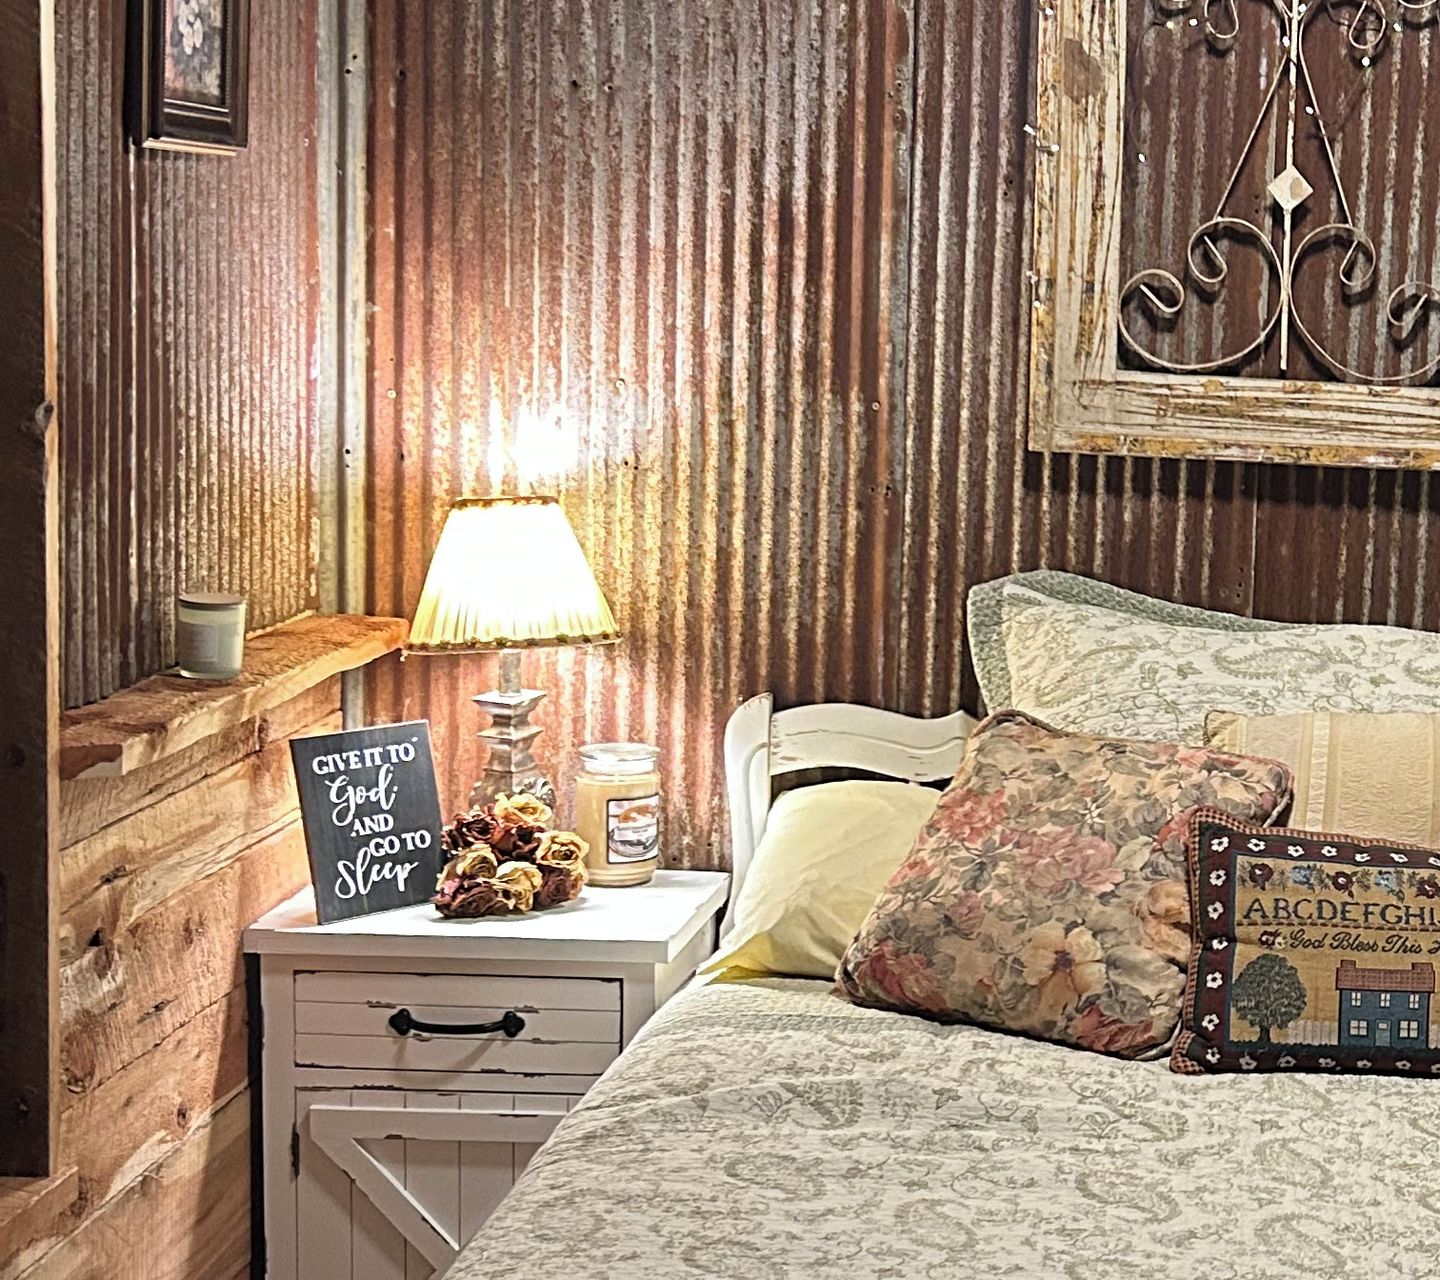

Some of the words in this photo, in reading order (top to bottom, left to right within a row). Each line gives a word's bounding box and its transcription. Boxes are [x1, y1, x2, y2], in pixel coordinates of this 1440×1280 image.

[312, 750, 362, 775] GIVE
[363, 746, 384, 767] IT
[387, 742, 416, 763] TO
[325, 763, 398, 827] God
[351, 813, 394, 837] AND
[369, 837, 400, 857] GO
[401, 829, 432, 851] TO
[335, 847, 419, 899] Sleep
[1289, 928, 1328, 950] God
[1329, 931, 1379, 953] Bless
[1382, 933, 1423, 954] This
